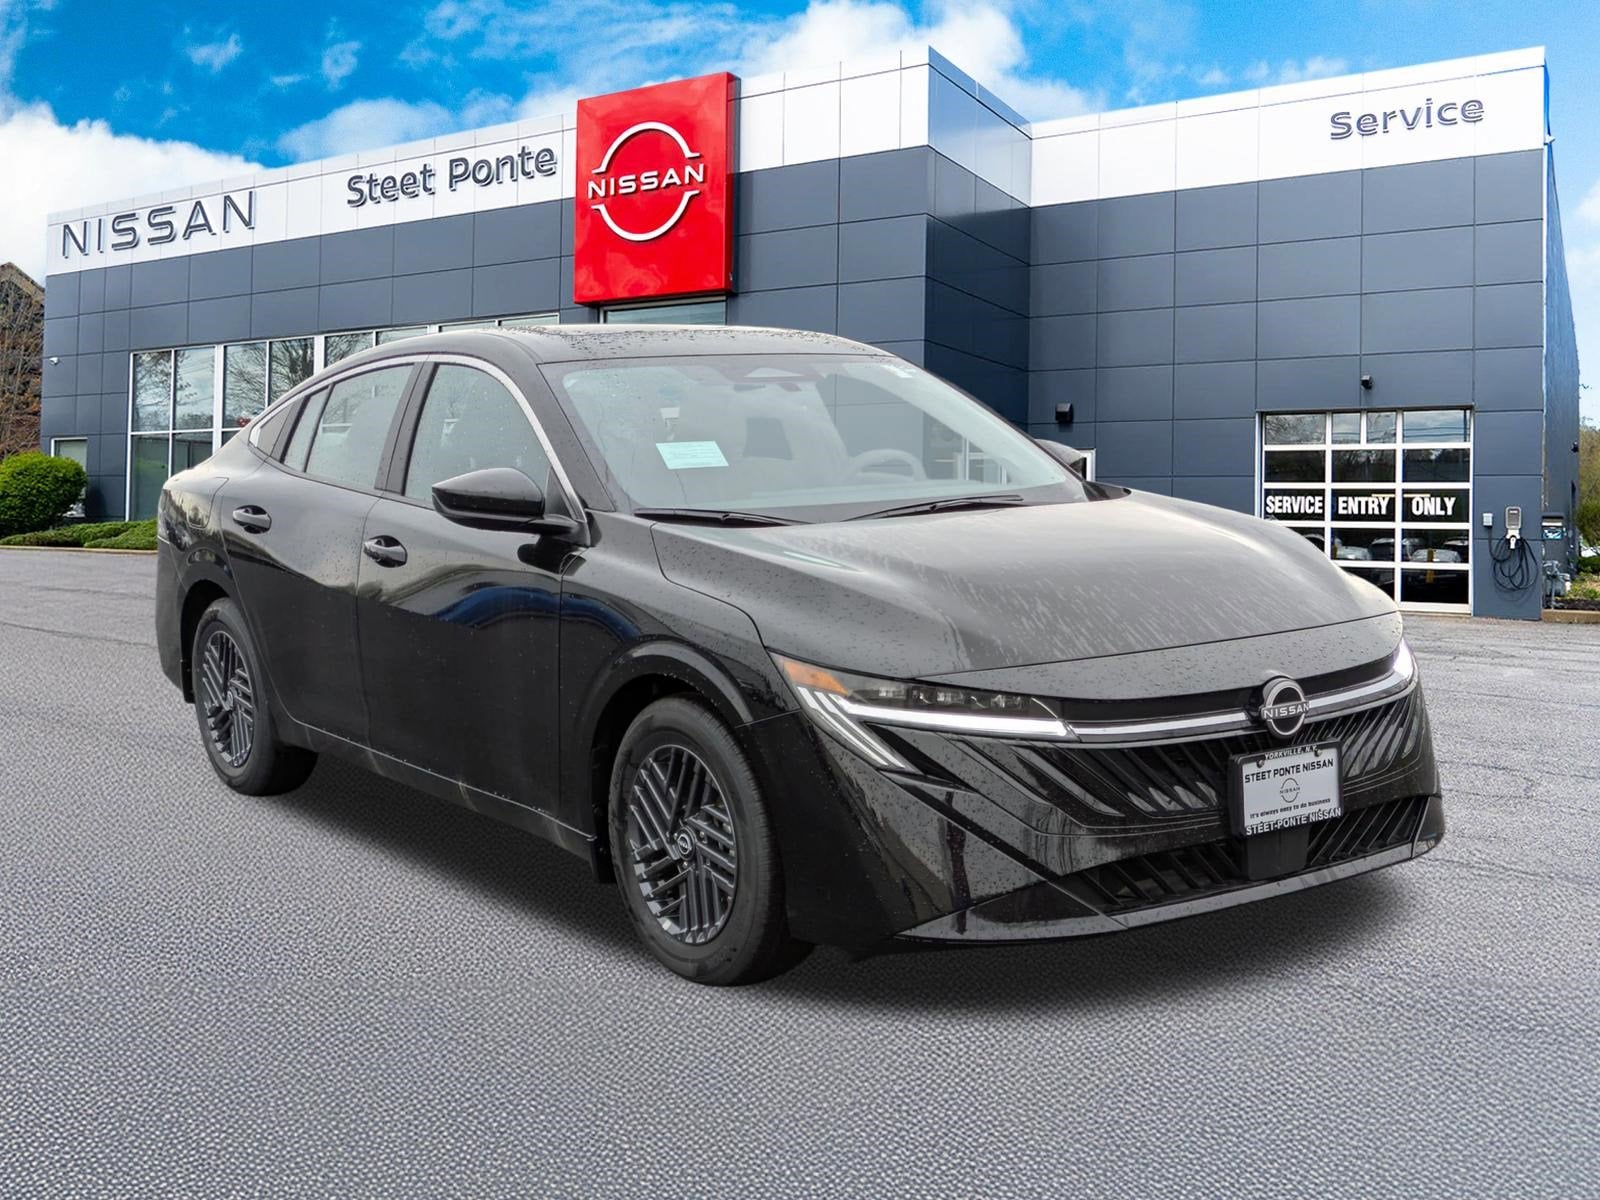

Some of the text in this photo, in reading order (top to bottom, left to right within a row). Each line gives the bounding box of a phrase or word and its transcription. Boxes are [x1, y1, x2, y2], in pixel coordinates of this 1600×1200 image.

[1330, 98, 1485, 141] Service
[347, 145, 558, 208] Steet Ponte
[587, 163, 705, 200] NISSAN
[62, 190, 256, 260] NISSAN
[1265, 495, 1456, 516] SERVICE ENTRY ONLY
[1263, 701, 1310, 719] NISSAN
[1244, 758, 1334, 784] STEET PONTE NISSAN
[1280, 786, 1300, 794] NISSAN
[1260, 809, 1279, 817] always
[1308, 798, 1331, 806] business
[1245, 807, 1342, 836] STEET-PONTE NISSAN
